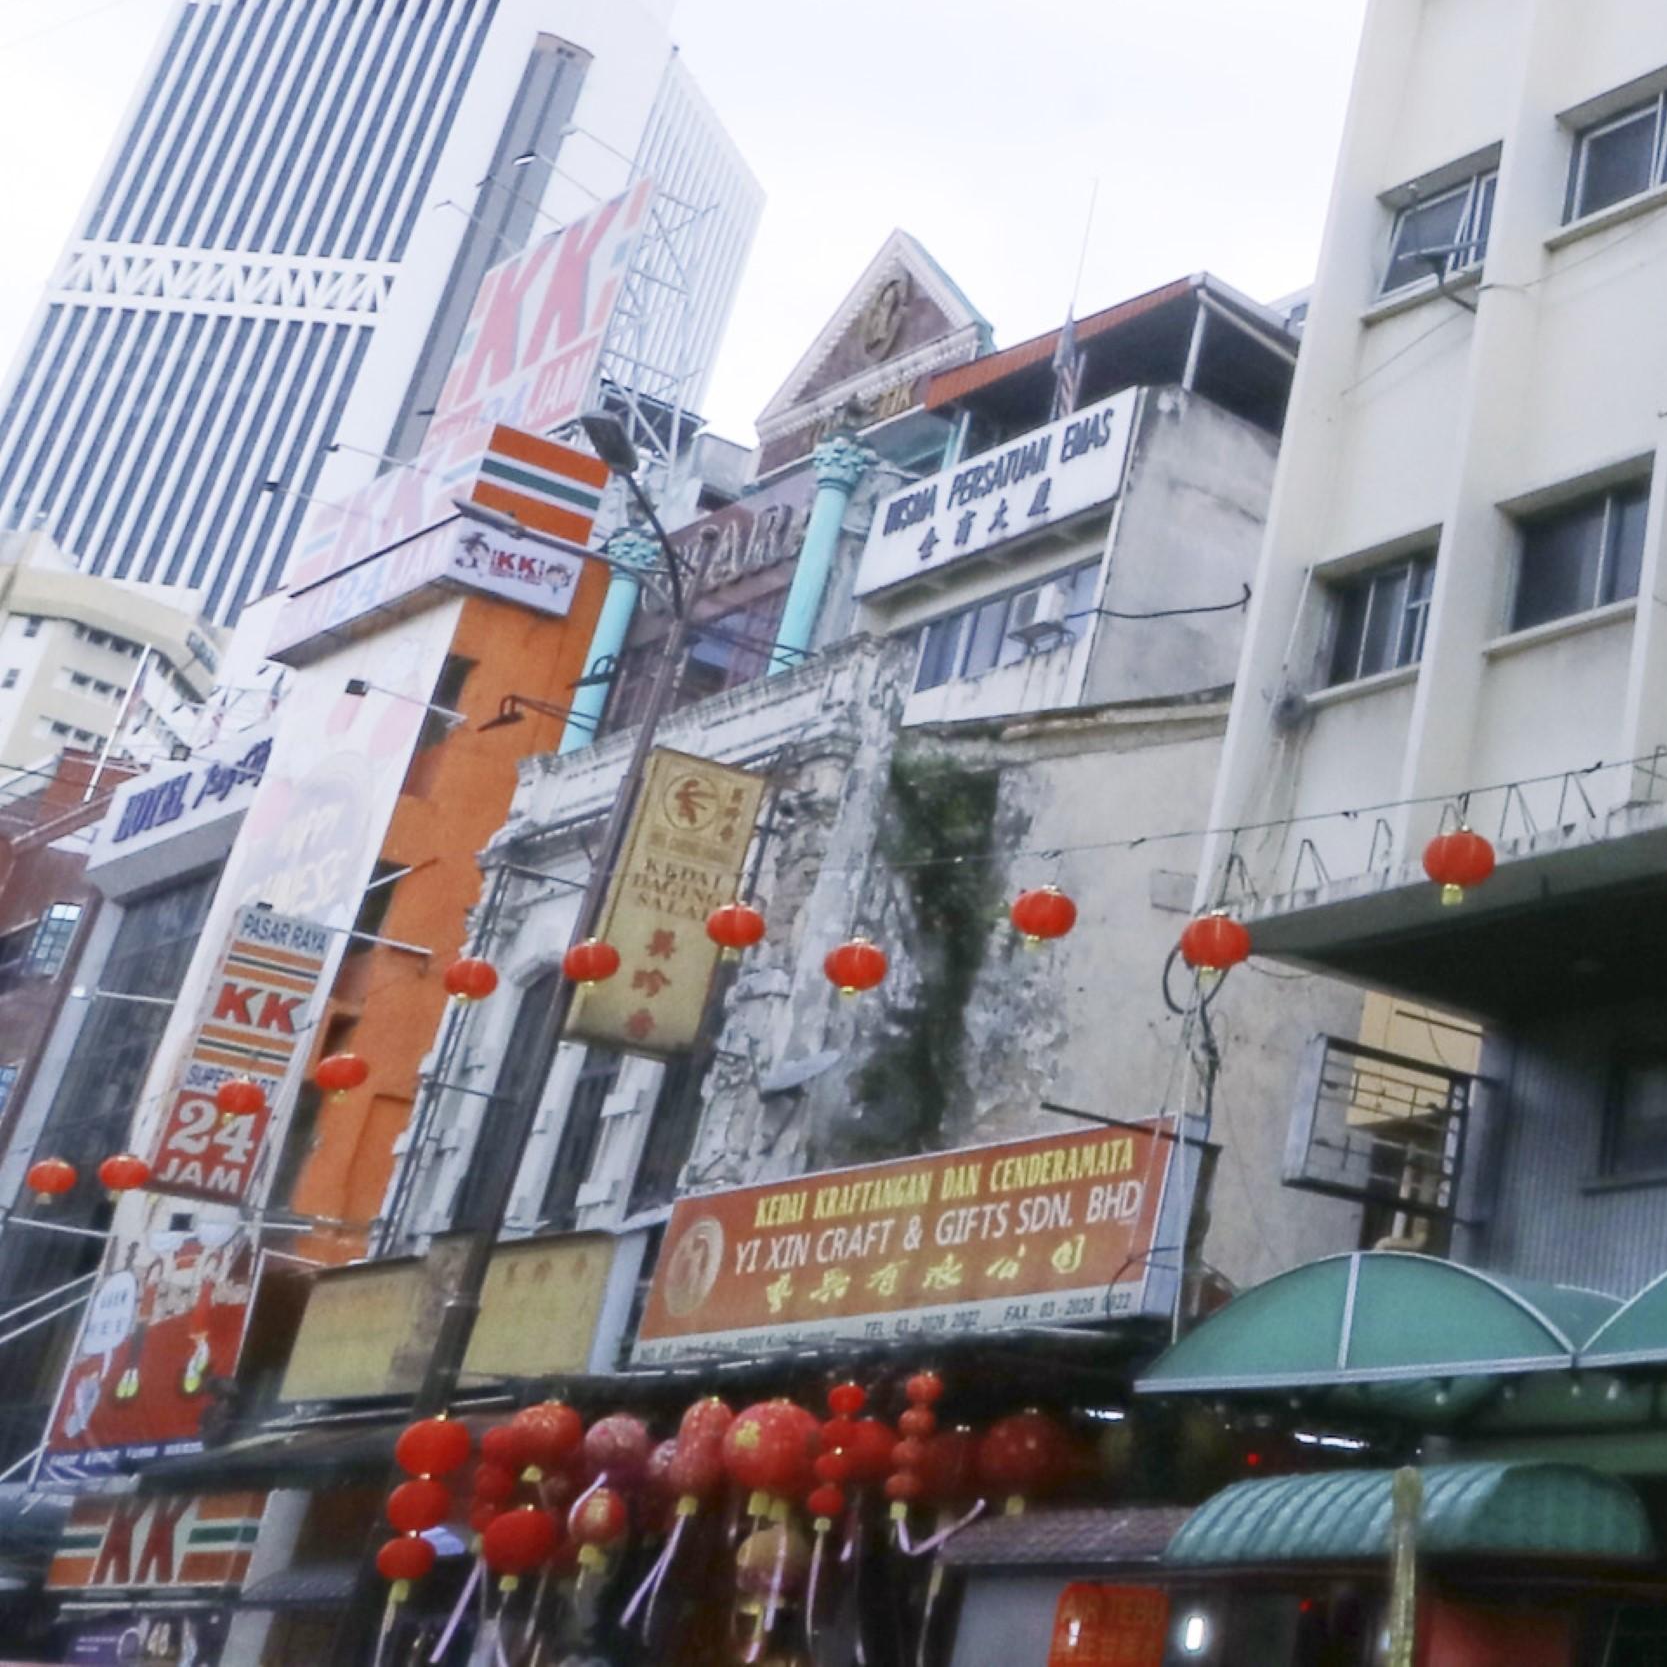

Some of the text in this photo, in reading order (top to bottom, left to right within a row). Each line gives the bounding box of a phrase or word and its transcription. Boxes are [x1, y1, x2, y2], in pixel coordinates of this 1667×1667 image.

[882, 407, 1115, 536] WISMA PERSATUAN EMAS
[112, 771, 193, 844] HOTEL
[240, 913, 329, 956] PASAR RAYA
[211, 981, 308, 1035] KK
[166, 1097, 256, 1163] 24
[157, 1156, 243, 1195] JAM
[753, 1138, 1135, 1229] KEDAI KRAFTANGAN DAN CENDERAMATA
[735, 1241, 761, 1275] YI
[764, 1232, 812, 1270] XIN
[816, 1220, 894, 1261] CRAFT
[903, 1213, 924, 1251] &
[935, 1202, 1009, 1246] GIFTS
[1016, 1192, 1074, 1233] SDN.
[1003, 1304, 1030, 1322] FAX
[93, 1494, 196, 1584] KK
